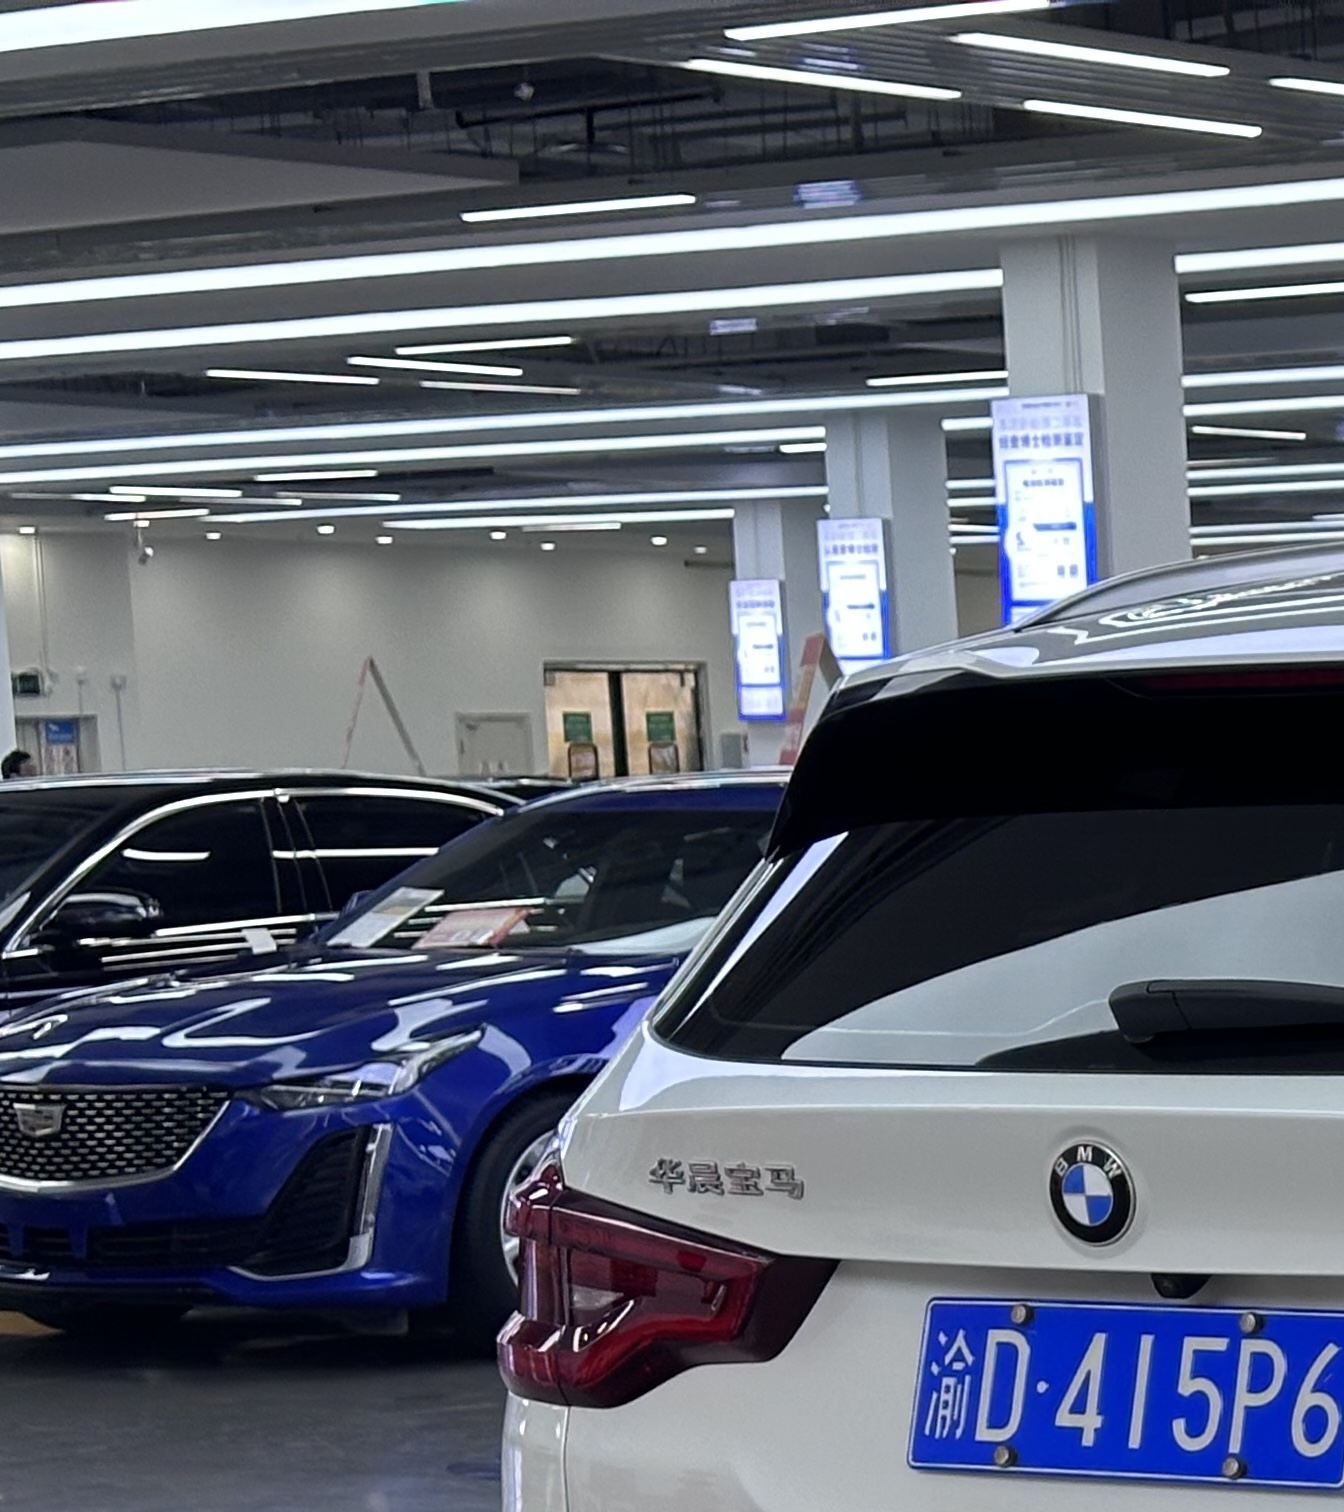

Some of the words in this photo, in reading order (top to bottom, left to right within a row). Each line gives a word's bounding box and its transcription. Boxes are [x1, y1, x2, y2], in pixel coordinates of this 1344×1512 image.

[648, 1157, 805, 1200] 华晨宝马
[1055, 1145, 1122, 1180] BMW
